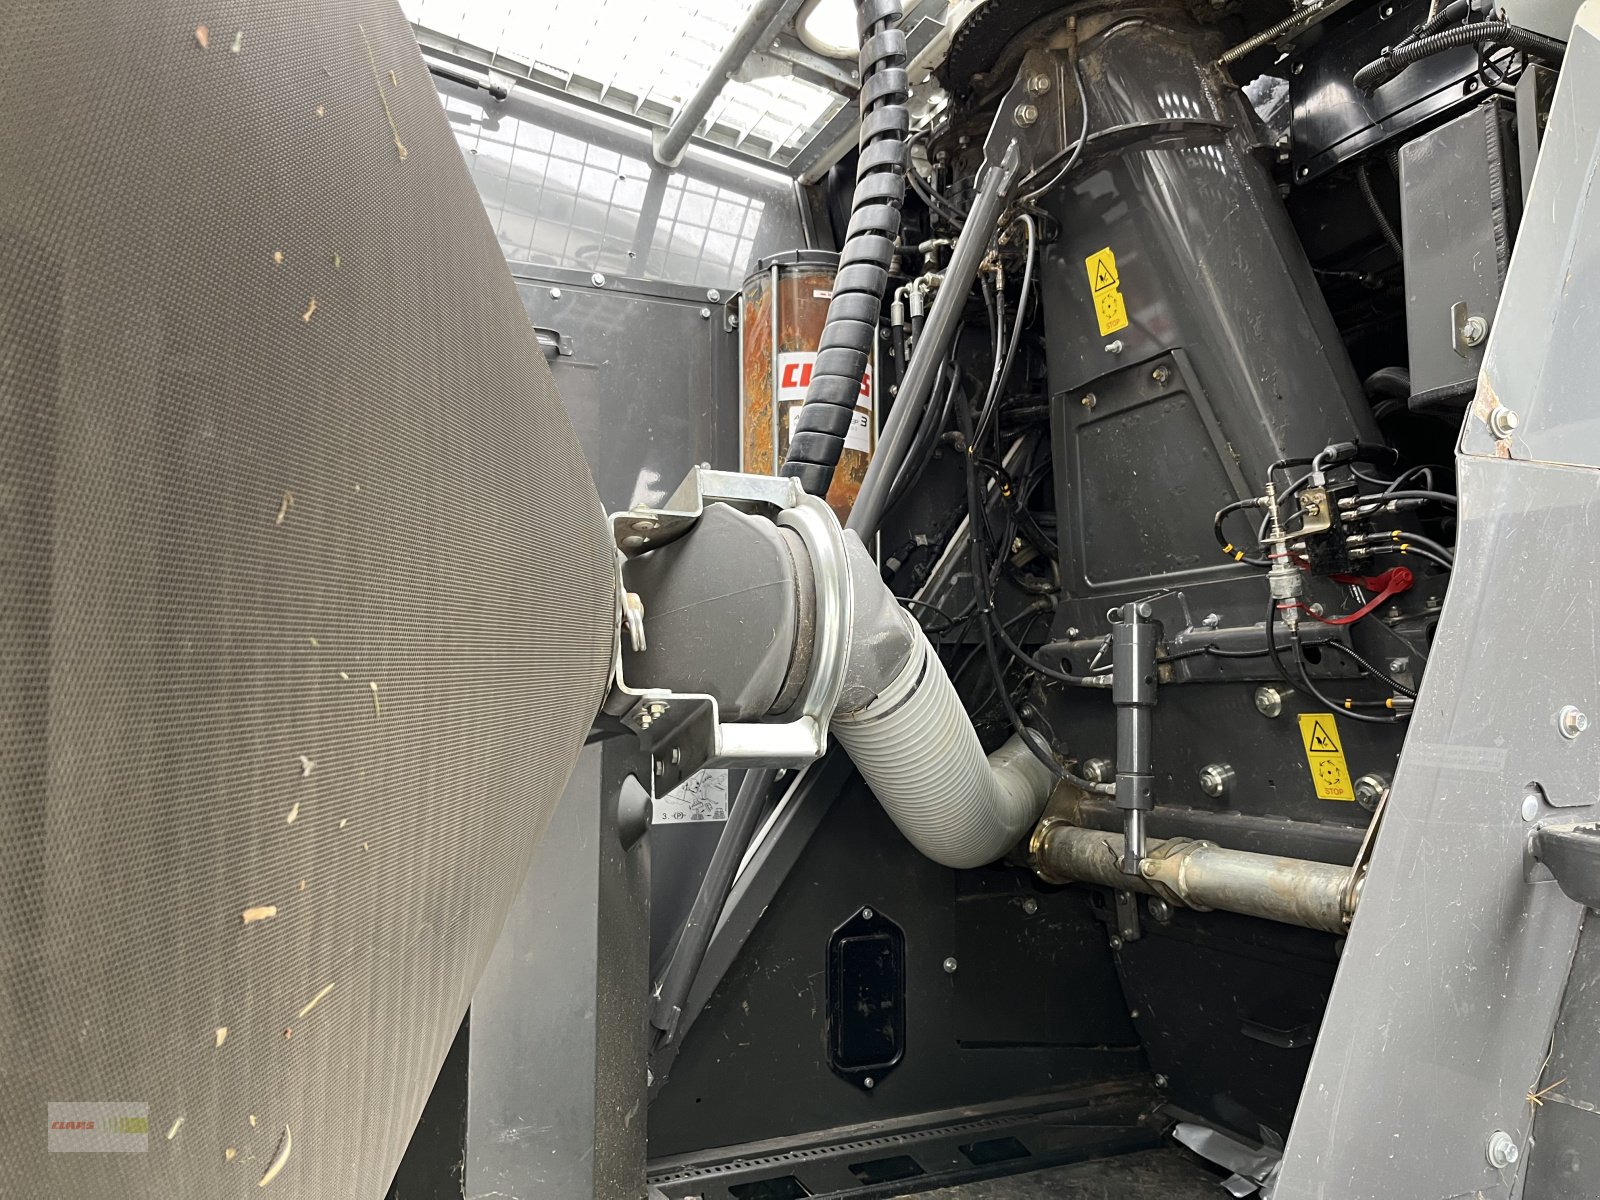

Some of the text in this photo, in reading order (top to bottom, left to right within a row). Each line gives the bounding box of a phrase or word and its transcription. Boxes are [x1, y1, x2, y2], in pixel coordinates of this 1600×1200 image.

[1106, 318, 1120, 330] STOP
[782, 363, 870, 397] CLS
[1324, 787, 1344, 796] STOP
